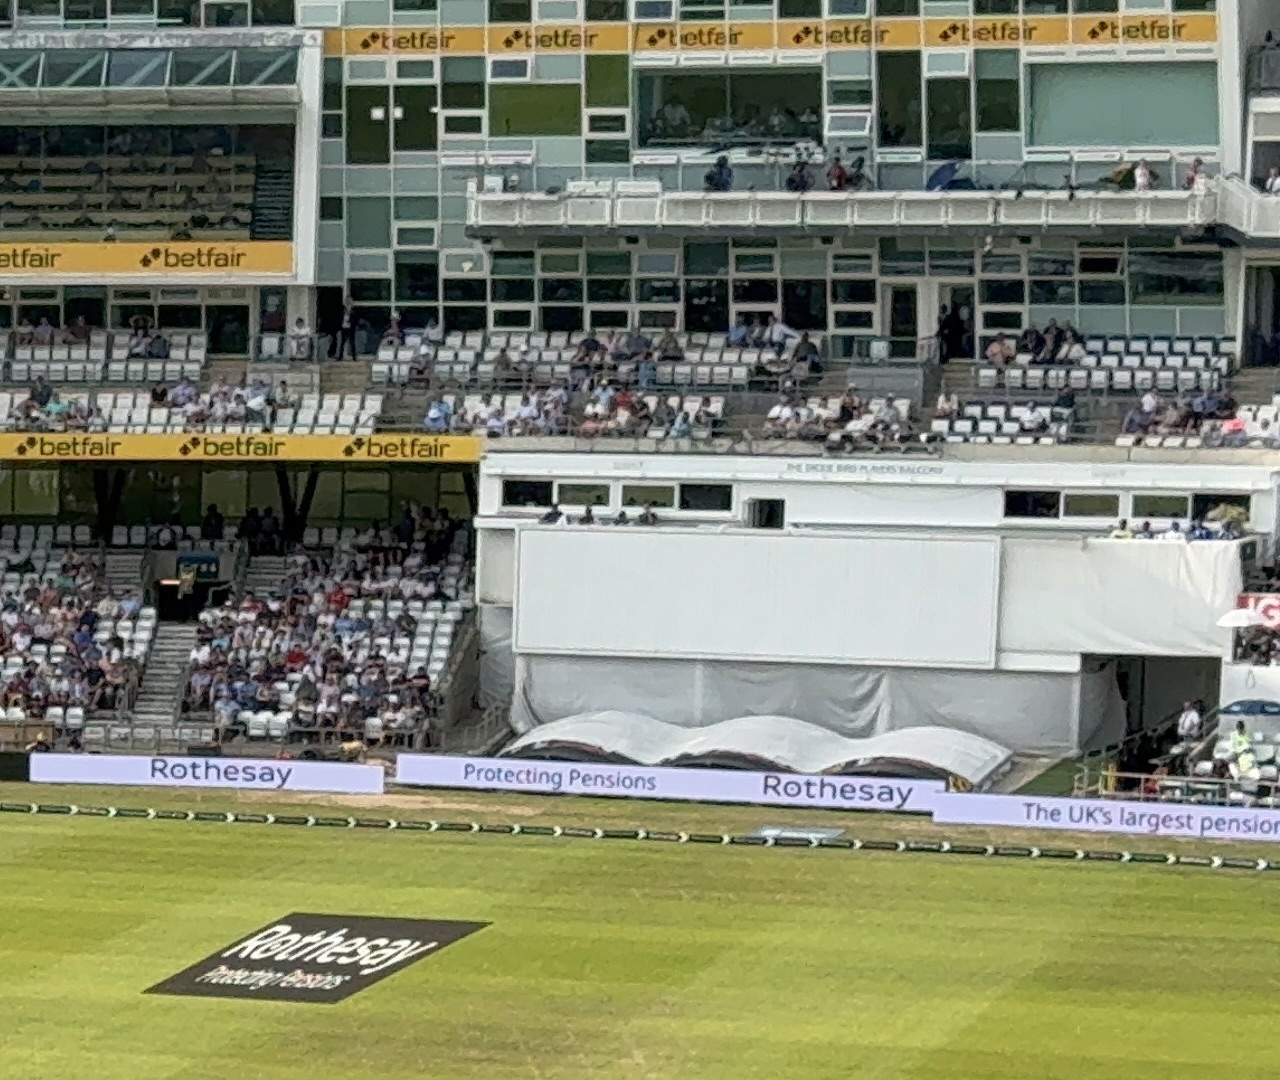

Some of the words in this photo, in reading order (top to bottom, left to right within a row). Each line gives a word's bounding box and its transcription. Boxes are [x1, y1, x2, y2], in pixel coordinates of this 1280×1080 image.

[381, 31, 456, 50] betfair
[524, 29, 599, 49] betfair
[668, 26, 743, 45] betfair
[812, 24, 889, 44] betfair
[961, 22, 1037, 43] betfair
[1110, 20, 1186, 40] betfair
[163, 247, 246, 269] betfair
[40, 437, 121, 458] betfair
[203, 437, 285, 458] betfair
[366, 437, 450, 458] betfair
[150, 757, 292, 787] Rothesay
[463, 763, 564, 788] Protecting
[568, 770, 657, 792] Pensions
[762, 773, 913, 809] Rothesay
[1022, 802, 1062, 824] The
[1118, 808, 1194, 836] largest
[221, 924, 438, 976] Rothesay
